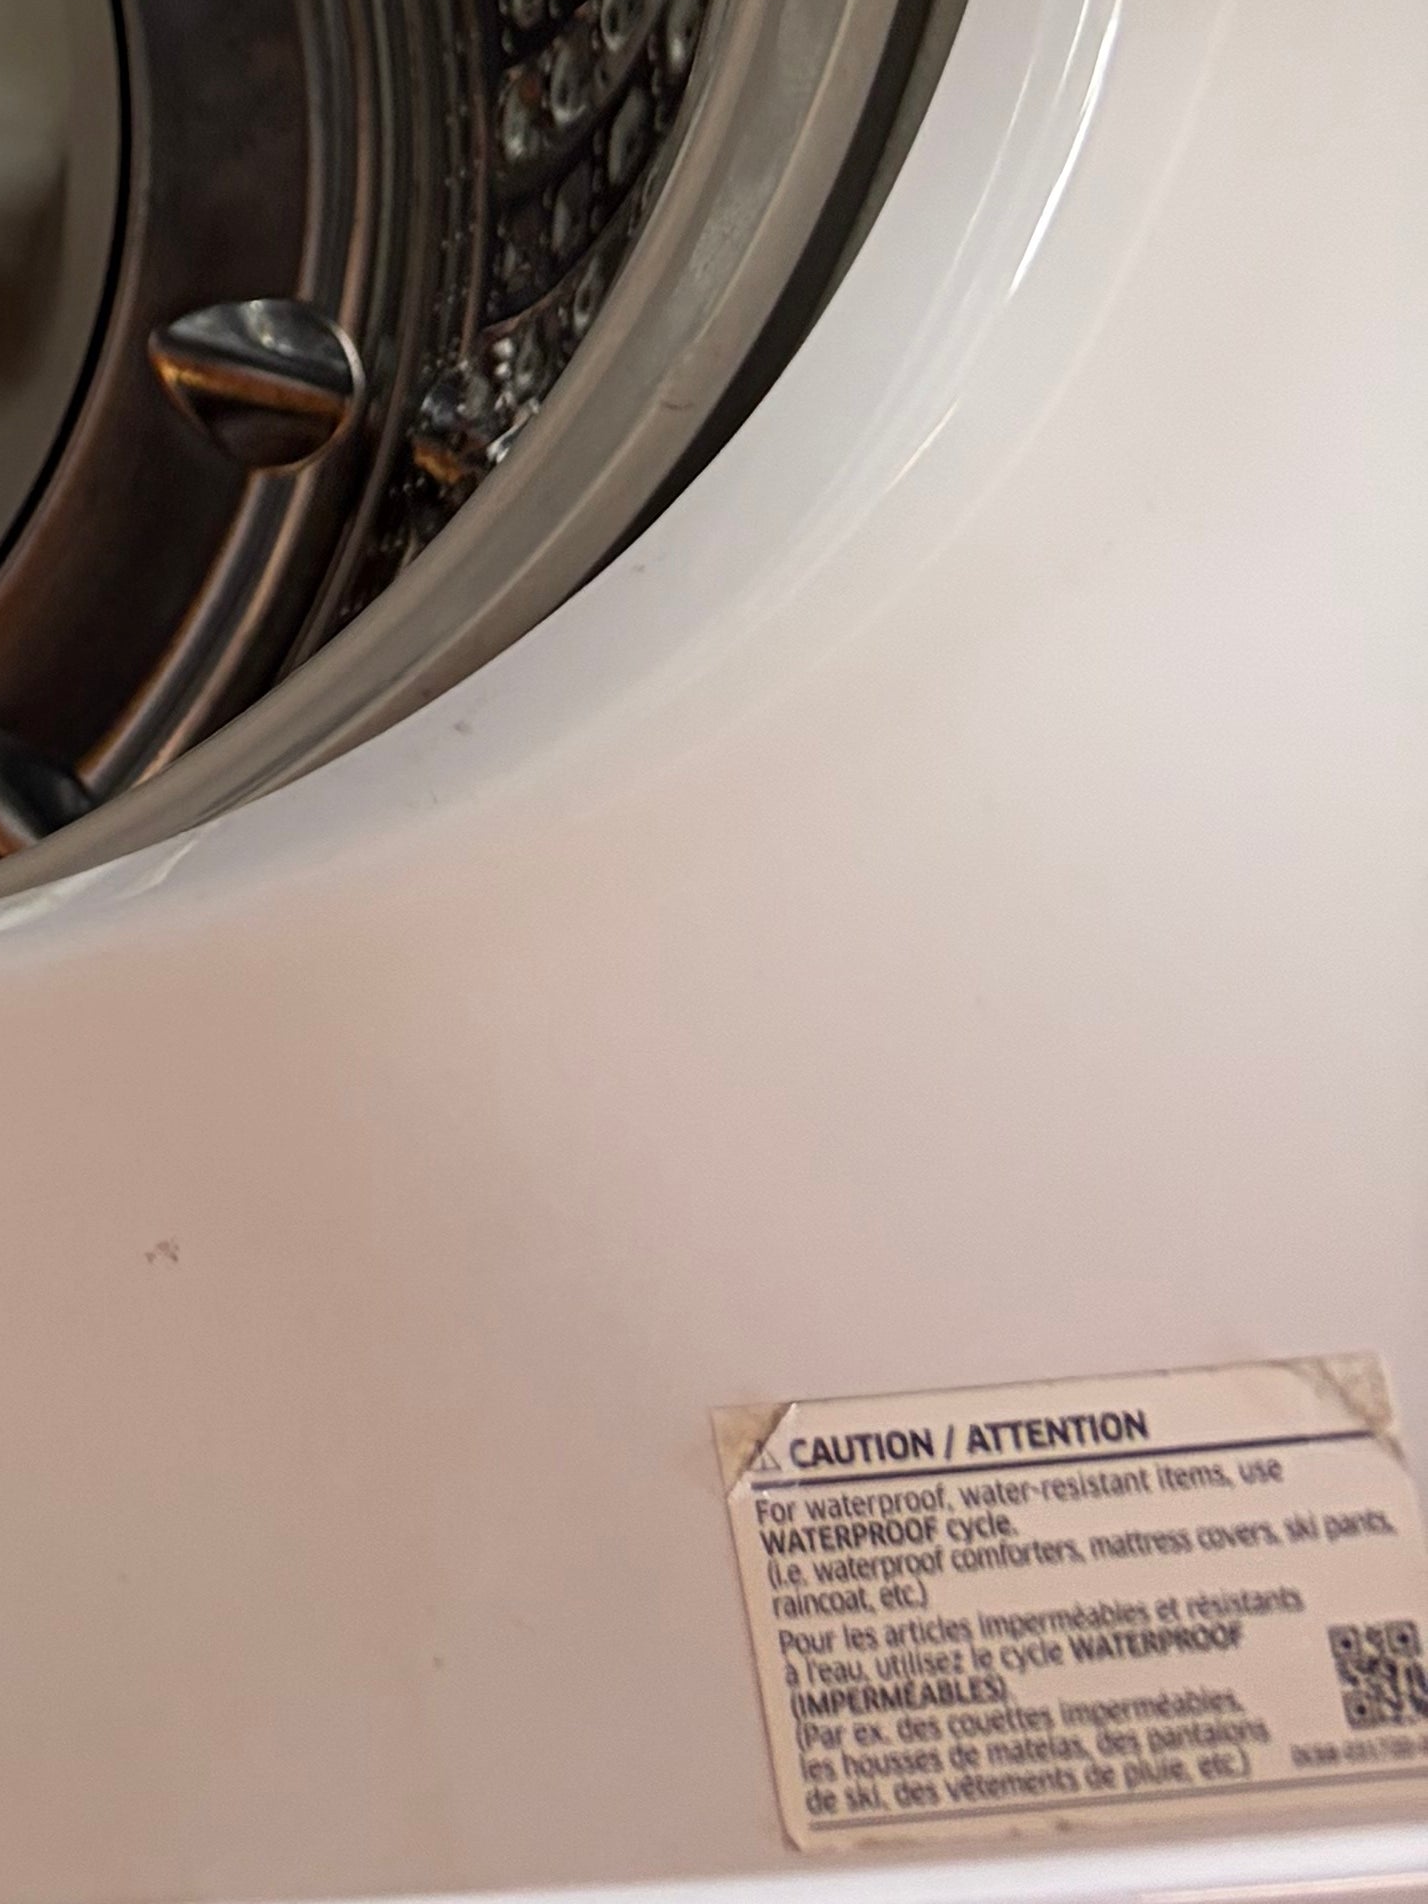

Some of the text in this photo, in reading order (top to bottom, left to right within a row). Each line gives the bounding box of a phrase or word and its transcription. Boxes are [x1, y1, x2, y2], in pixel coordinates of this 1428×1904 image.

[790, 1428, 934, 1469] CAUTION
[966, 1410, 1148, 1456] ATTENTION
[756, 1499, 796, 1527] For
[962, 1470, 1150, 1508] water-resistant
[1155, 1463, 1233, 1495] items,
[1240, 1459, 1281, 1485] use
[759, 1513, 1016, 1557] WATERPROOF cycle.
[771, 1587, 875, 1620] raincoat,
[779, 1616, 972, 1657] Pour les articles
